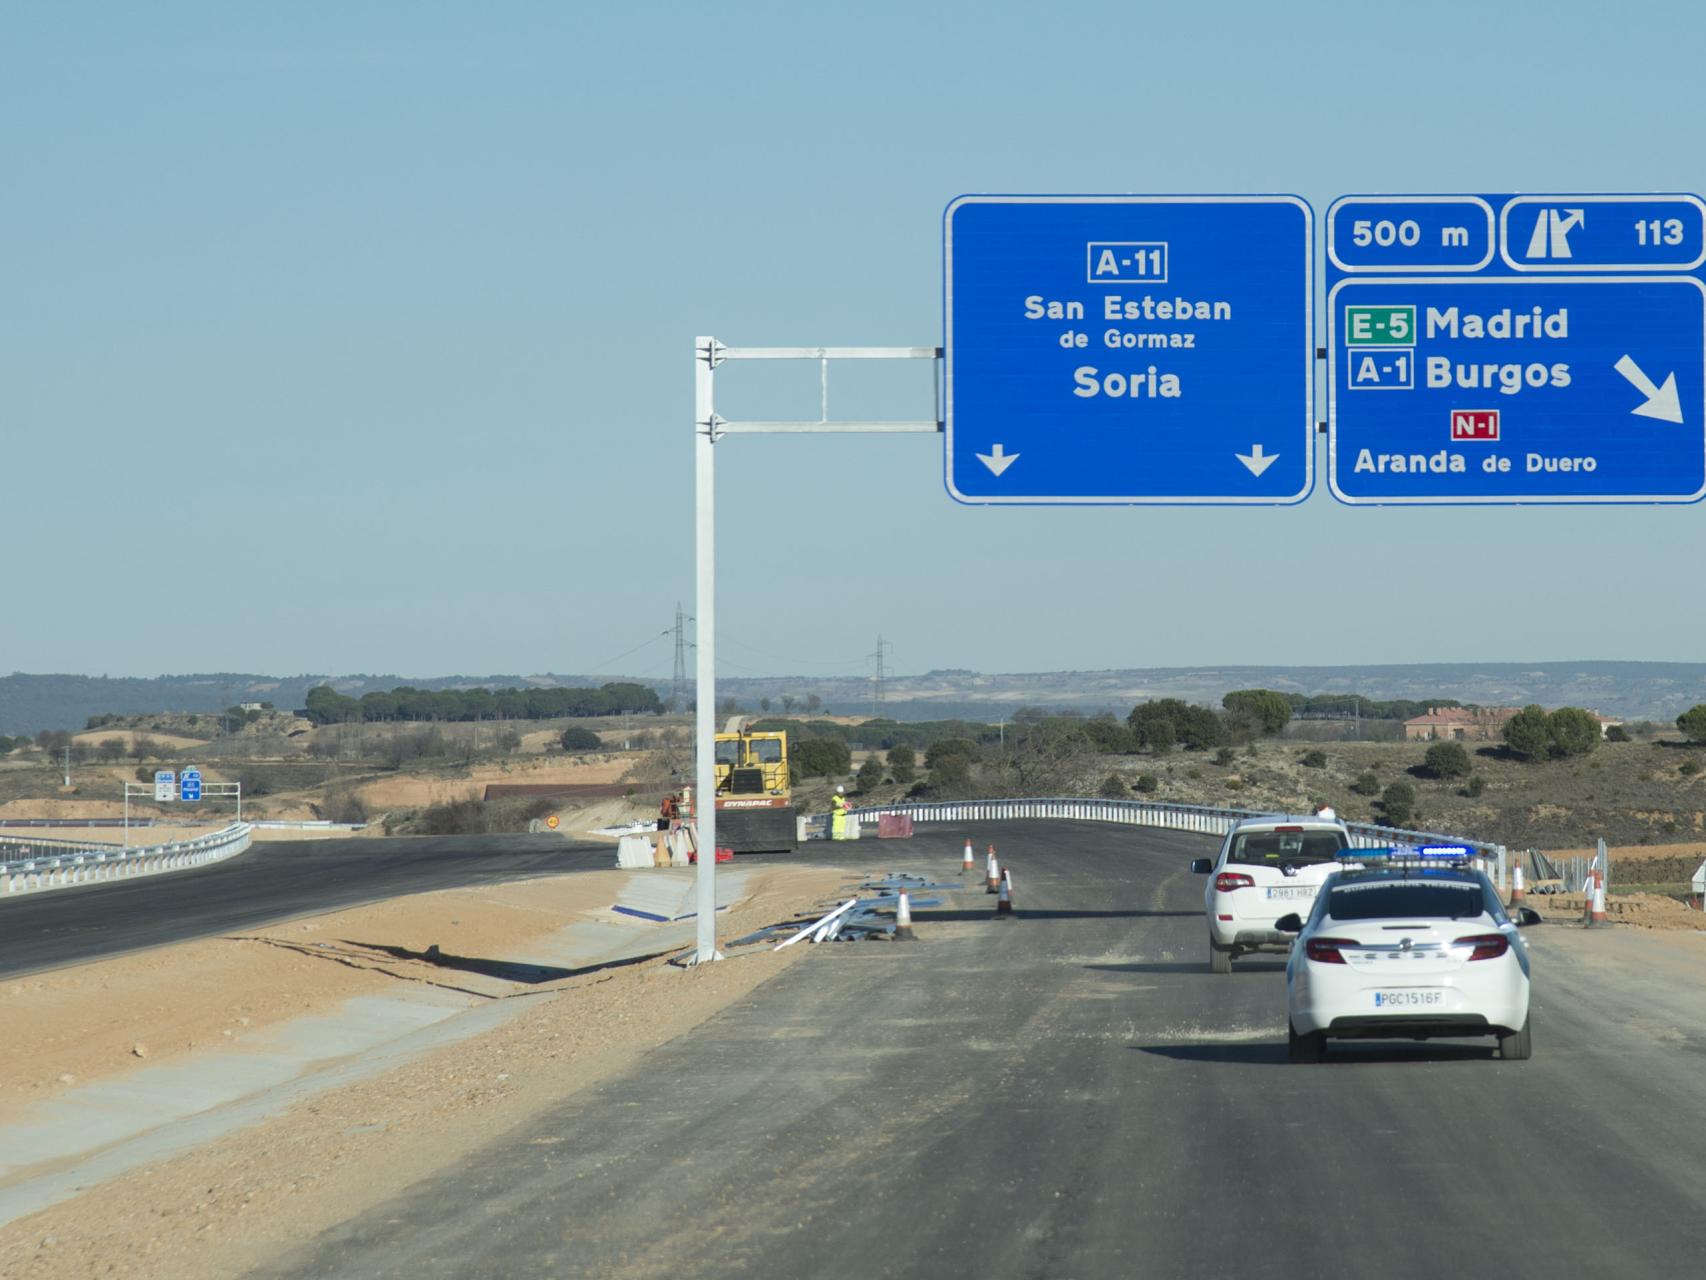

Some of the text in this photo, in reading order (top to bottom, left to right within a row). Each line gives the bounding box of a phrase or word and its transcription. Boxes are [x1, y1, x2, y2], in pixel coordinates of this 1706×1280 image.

[1352, 219, 1469, 247] 500 m
[1634, 219, 1684, 246] 113
[1095, 249, 1161, 275] A-11
[1024, 295, 1232, 320] San Esteban
[1352, 312, 1409, 339] E-5
[1426, 305, 1569, 339] Madrid
[1059, 328, 1196, 349] de Gormaz
[1072, 365, 1182, 398] Soria
[1356, 356, 1407, 382] A-1
[1426, 356, 1572, 395] Burgos
[1353, 448, 1598, 473] Aranda de Duero
[723, 799, 773, 808] DYNAPAC
[1381, 992, 1442, 1005] PGC1516F
